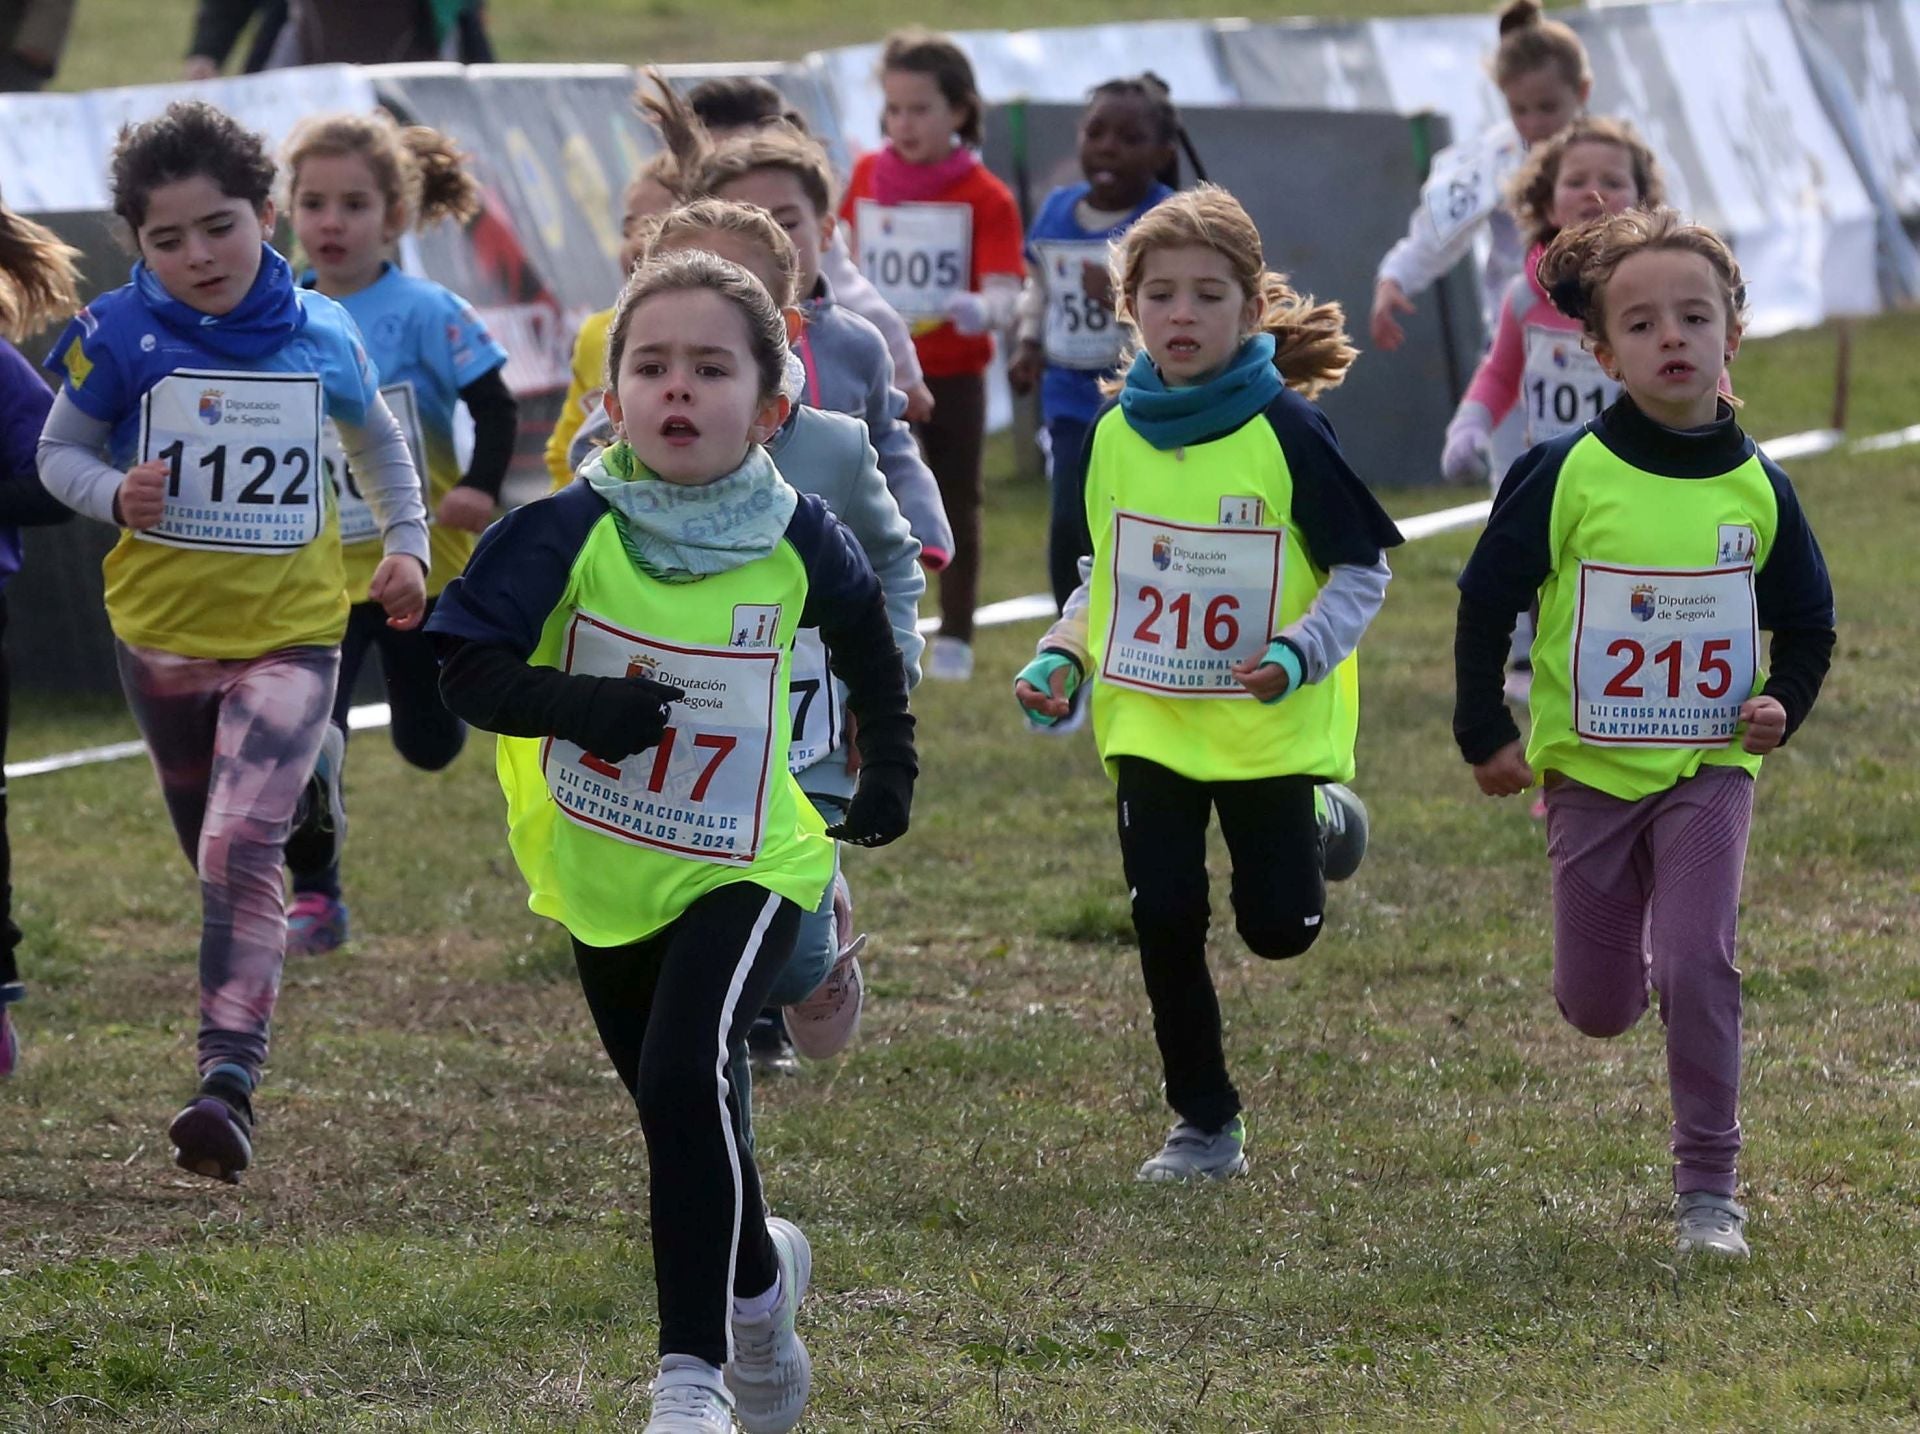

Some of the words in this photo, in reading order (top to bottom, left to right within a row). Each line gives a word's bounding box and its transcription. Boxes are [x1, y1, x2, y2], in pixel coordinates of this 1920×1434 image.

[866, 248, 960, 289] 1005
[225, 399, 281, 412] Diputación
[1533, 377, 1623, 423] 101
[224, 415, 239, 424] de
[241, 415, 281, 427] Segovia
[158, 440, 311, 504] 1122
[178, 507, 219, 521] CROSS
[223, 512, 287, 524] NACIONAL
[273, 529, 304, 541] 2024
[1173, 547, 1227, 561] Diputación
[1172, 562, 1184, 571] de
[1185, 565, 1226, 576] Segovia
[1658, 594, 1716, 606] Diputación
[1133, 585, 1241, 651] 216
[1657, 610, 1672, 619] de
[1675, 609, 1716, 621] Segovia
[1136, 652, 1166, 666] CROSS
[1167, 658, 1232, 670] NACIONAL
[1603, 638, 1732, 699] 215
[658, 671, 727, 691] Diputación
[1117, 662, 1204, 686] CANTIMPALOS
[1590, 704, 1608, 717] LII
[1612, 707, 1654, 718] CROSS
[1658, 706, 1727, 719] NACIONAL
[1590, 721, 1699, 735] CANTIMPALOS
[1712, 723, 1735, 736] 202
[578, 726, 737, 802] 17
[559, 768, 580, 788] LII
[582, 780, 629, 807] CROSS
[633, 801, 715, 829] NACIONAL
[719, 816, 738, 830] DE
[556, 785, 678, 840] CANTIMPALOS
[691, 832, 735, 849] 2024
